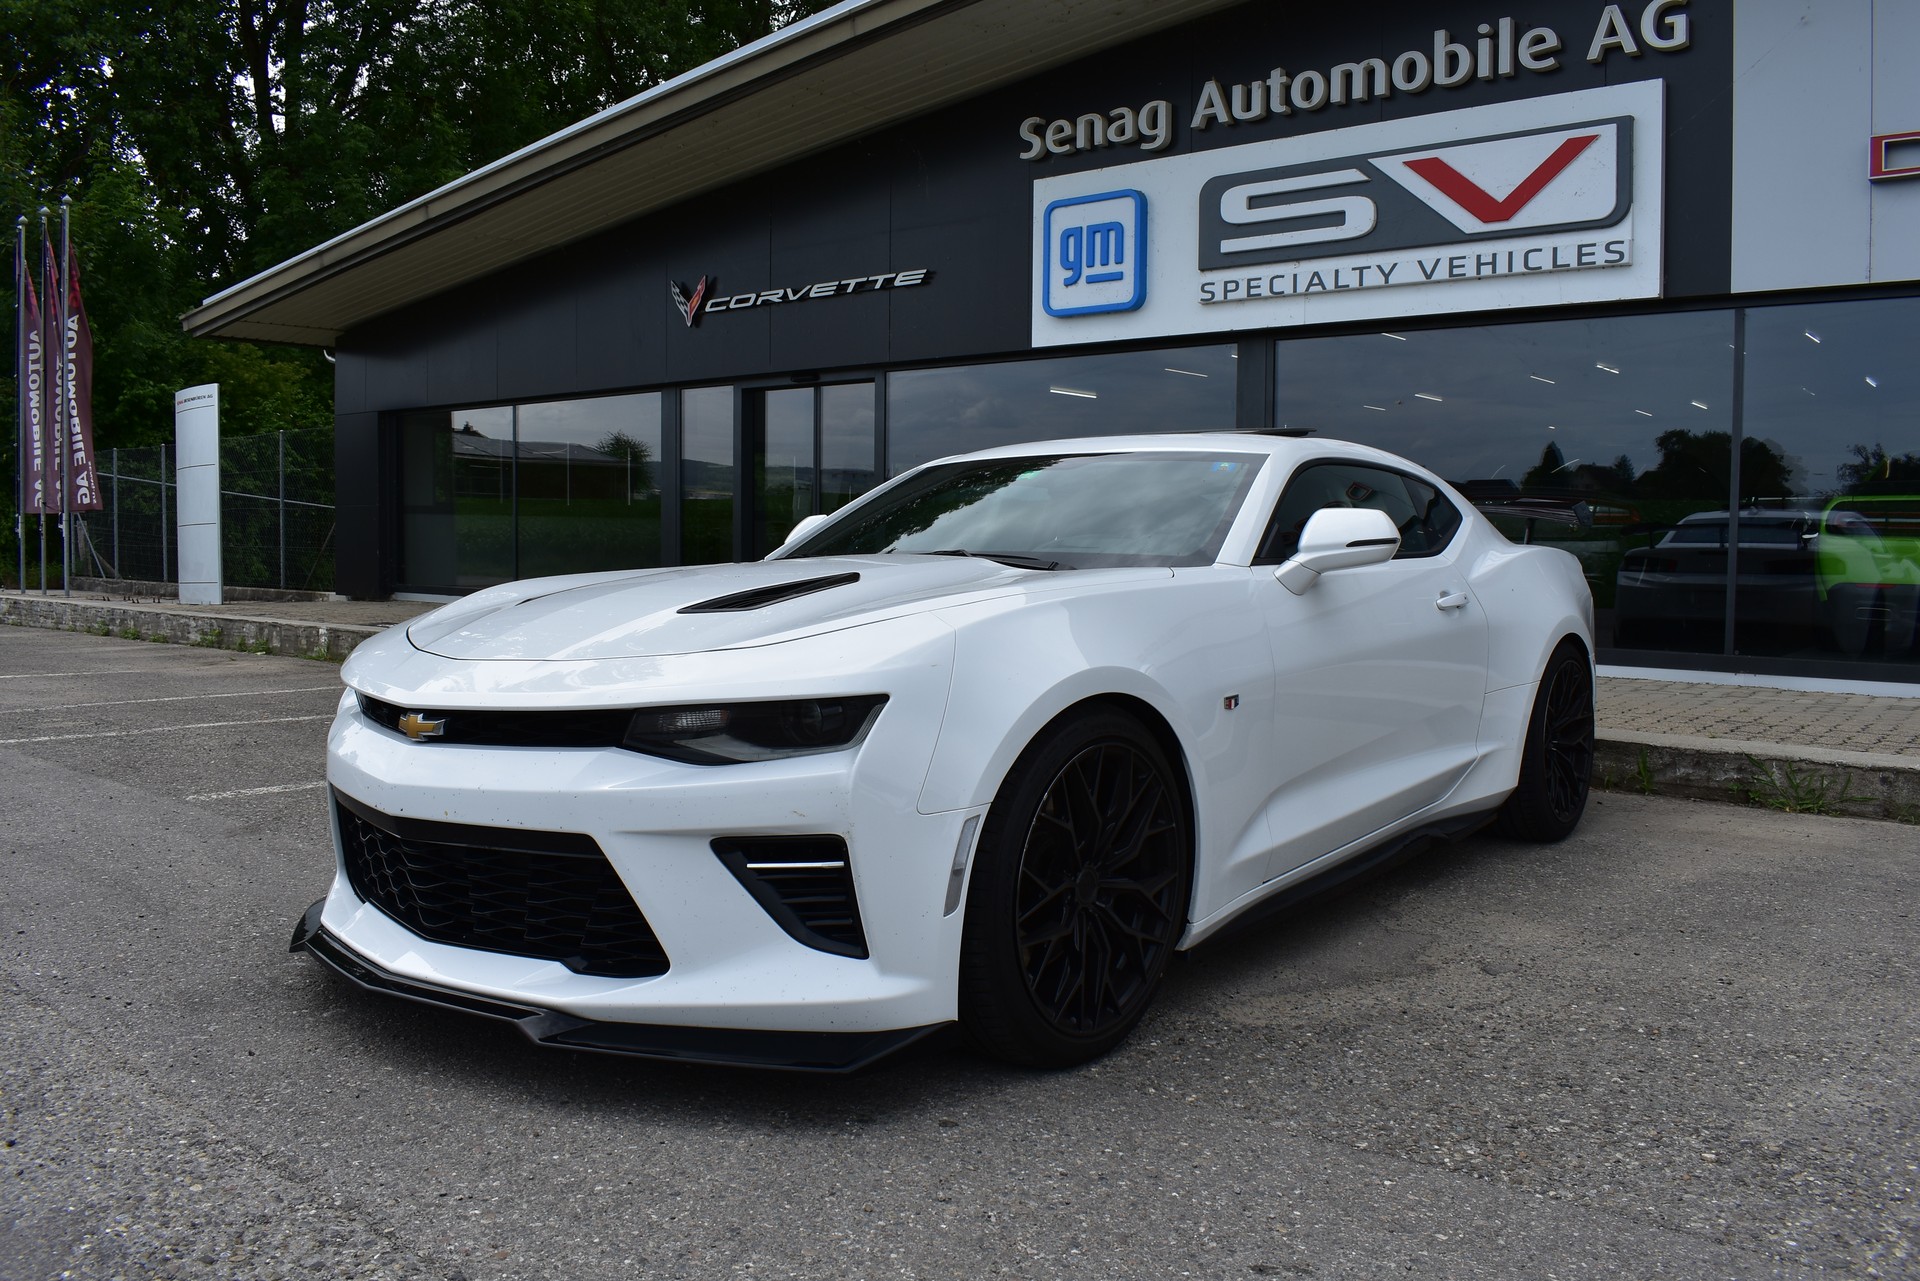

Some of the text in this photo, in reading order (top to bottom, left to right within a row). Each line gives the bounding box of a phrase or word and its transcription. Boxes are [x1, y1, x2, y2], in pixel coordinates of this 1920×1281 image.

[1019, 0, 1691, 161] Senag Automobile AG
[1060, 220, 1125, 287] gm
[1200, 240, 1626, 303] SPECIALTY VEHICLES
[704, 268, 928, 312] CORVETTE
